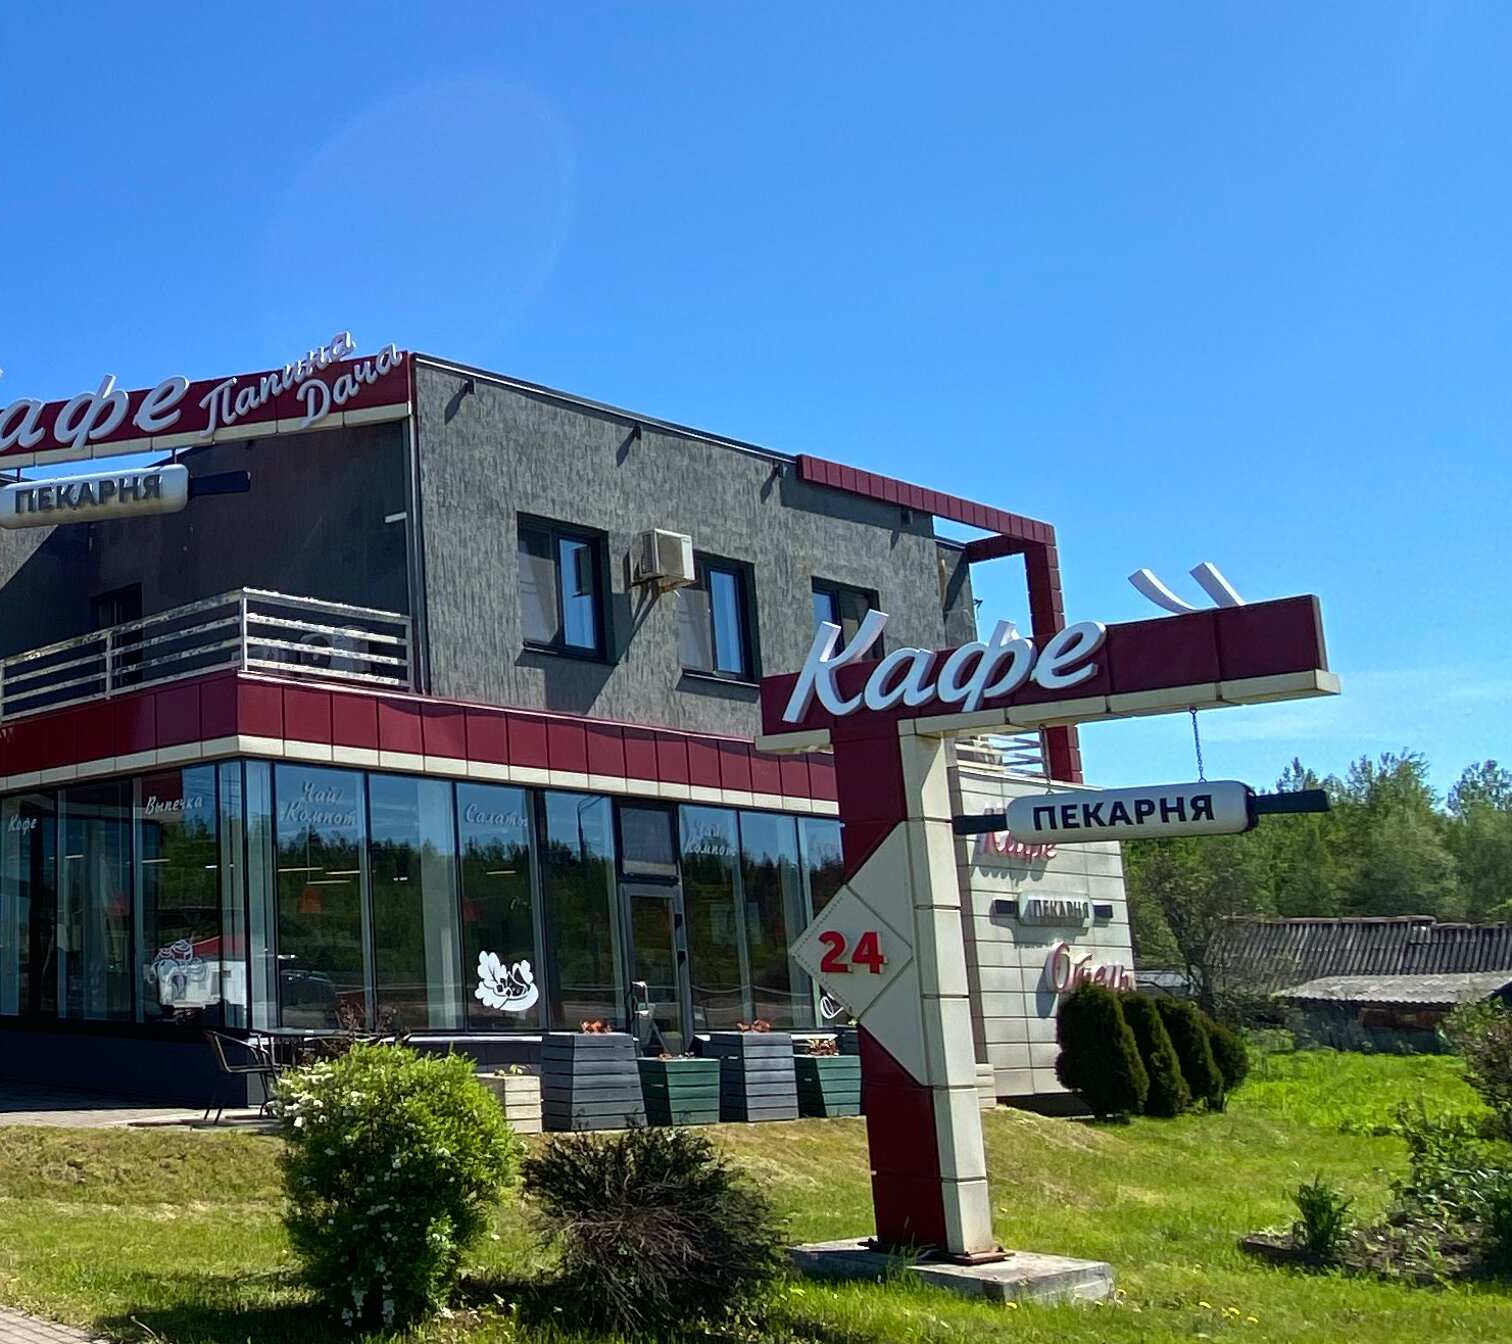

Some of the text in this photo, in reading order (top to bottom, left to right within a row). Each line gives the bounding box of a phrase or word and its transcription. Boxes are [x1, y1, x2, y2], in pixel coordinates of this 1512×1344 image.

[199, 330, 356, 439] Папина
[296, 343, 403, 431] Дача
[14, 473, 162, 514] ПЕКАРНЯ
[782, 609, 1107, 724] Кафе
[144, 795, 203, 815] Выпечка
[285, 801, 358, 826] Компот
[465, 803, 528, 828] Салаты
[1033, 794, 1216, 832] ПЕКАРНЯ
[7, 813, 38, 837] Кофе
[818, 930, 885, 974] 24
